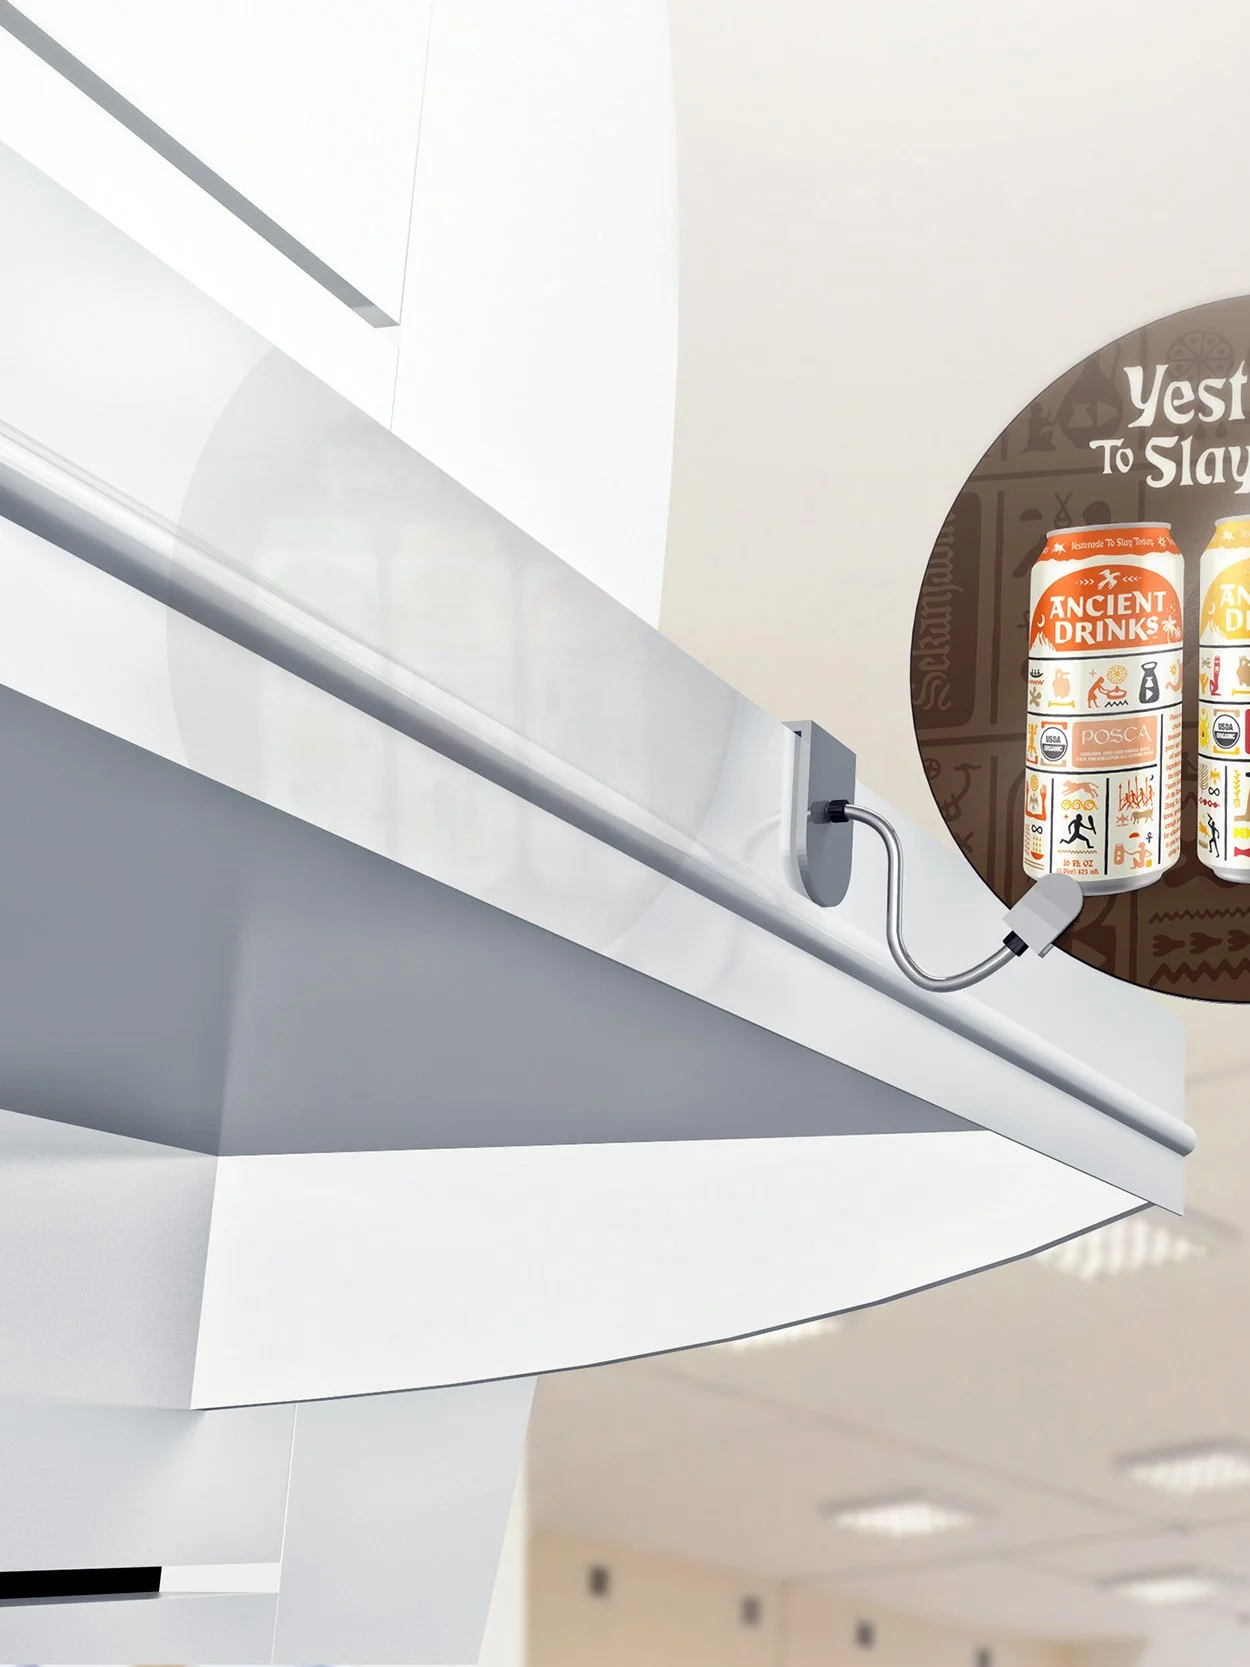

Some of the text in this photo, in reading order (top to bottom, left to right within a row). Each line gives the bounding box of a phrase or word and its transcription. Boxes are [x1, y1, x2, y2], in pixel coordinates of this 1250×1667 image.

[1089, 438, 1134, 475] To
[1105, 538, 1115, 548] To
[1050, 590, 1167, 620] ANCIENT
[1055, 616, 1159, 645] DRINKS
[1081, 725, 1152, 745] POSCA
[1218, 723, 1233, 731] USDA
[1046, 735, 1061, 744] USDA
